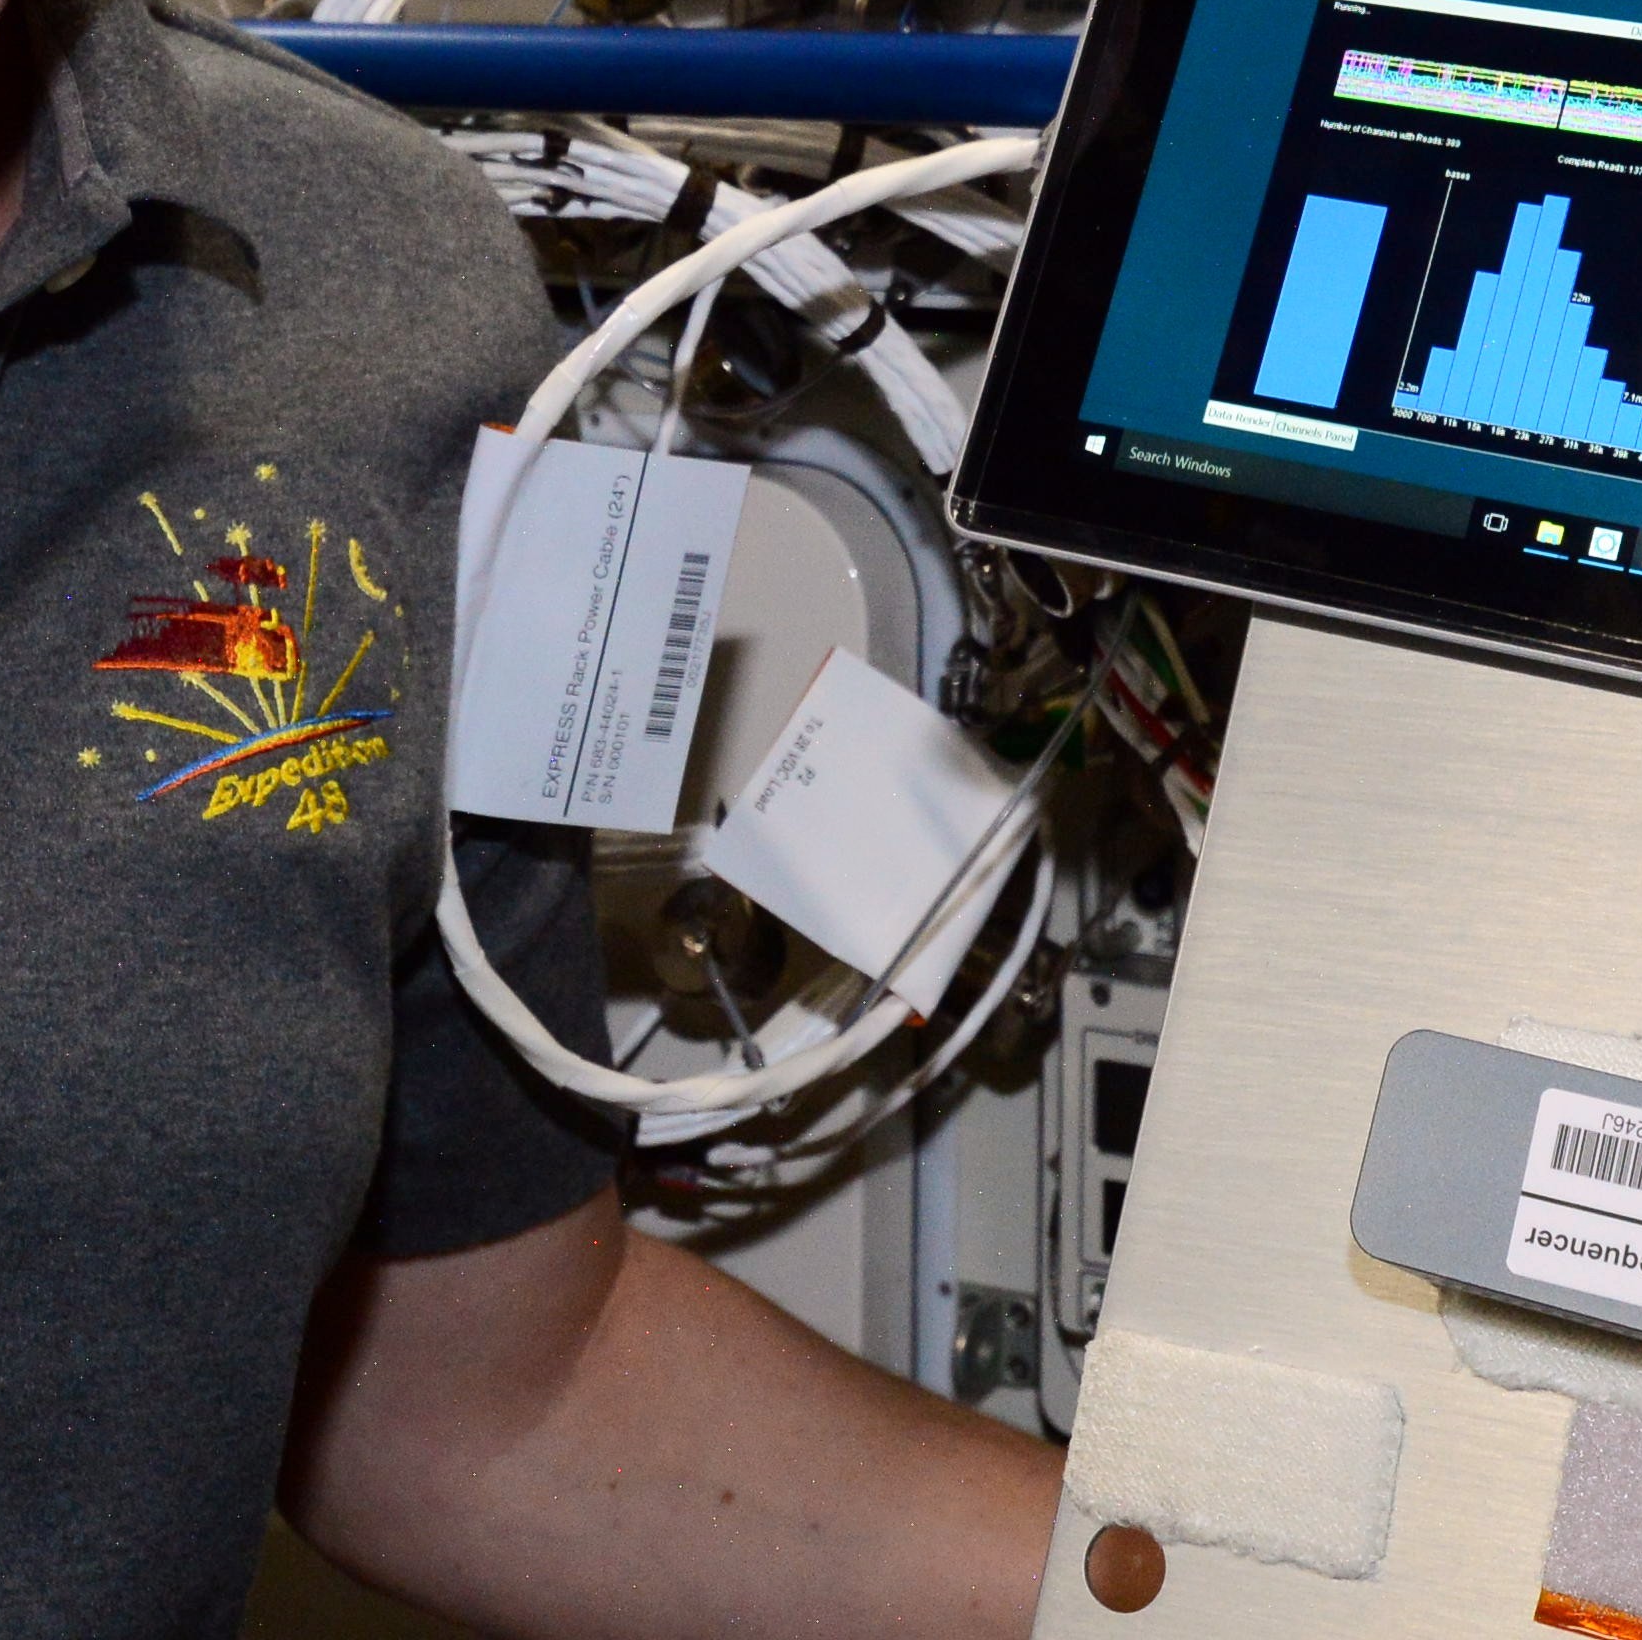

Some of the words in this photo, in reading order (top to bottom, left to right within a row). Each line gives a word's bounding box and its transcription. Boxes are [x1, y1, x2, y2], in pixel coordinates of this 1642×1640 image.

[1129, 446, 1171, 467] Search
[1175, 455, 1231, 479] Windows
[541, 701, 577, 799] EXPRESS
[566, 649, 589, 697] Rack
[578, 586, 604, 644] Power
[592, 524, 619, 580] Cable
[590, 669, 622, 769] 683-44024-1
[607, 712, 630, 770] 000101
[202, 735, 388, 821] Expedition
[286, 780, 350, 834] 48
